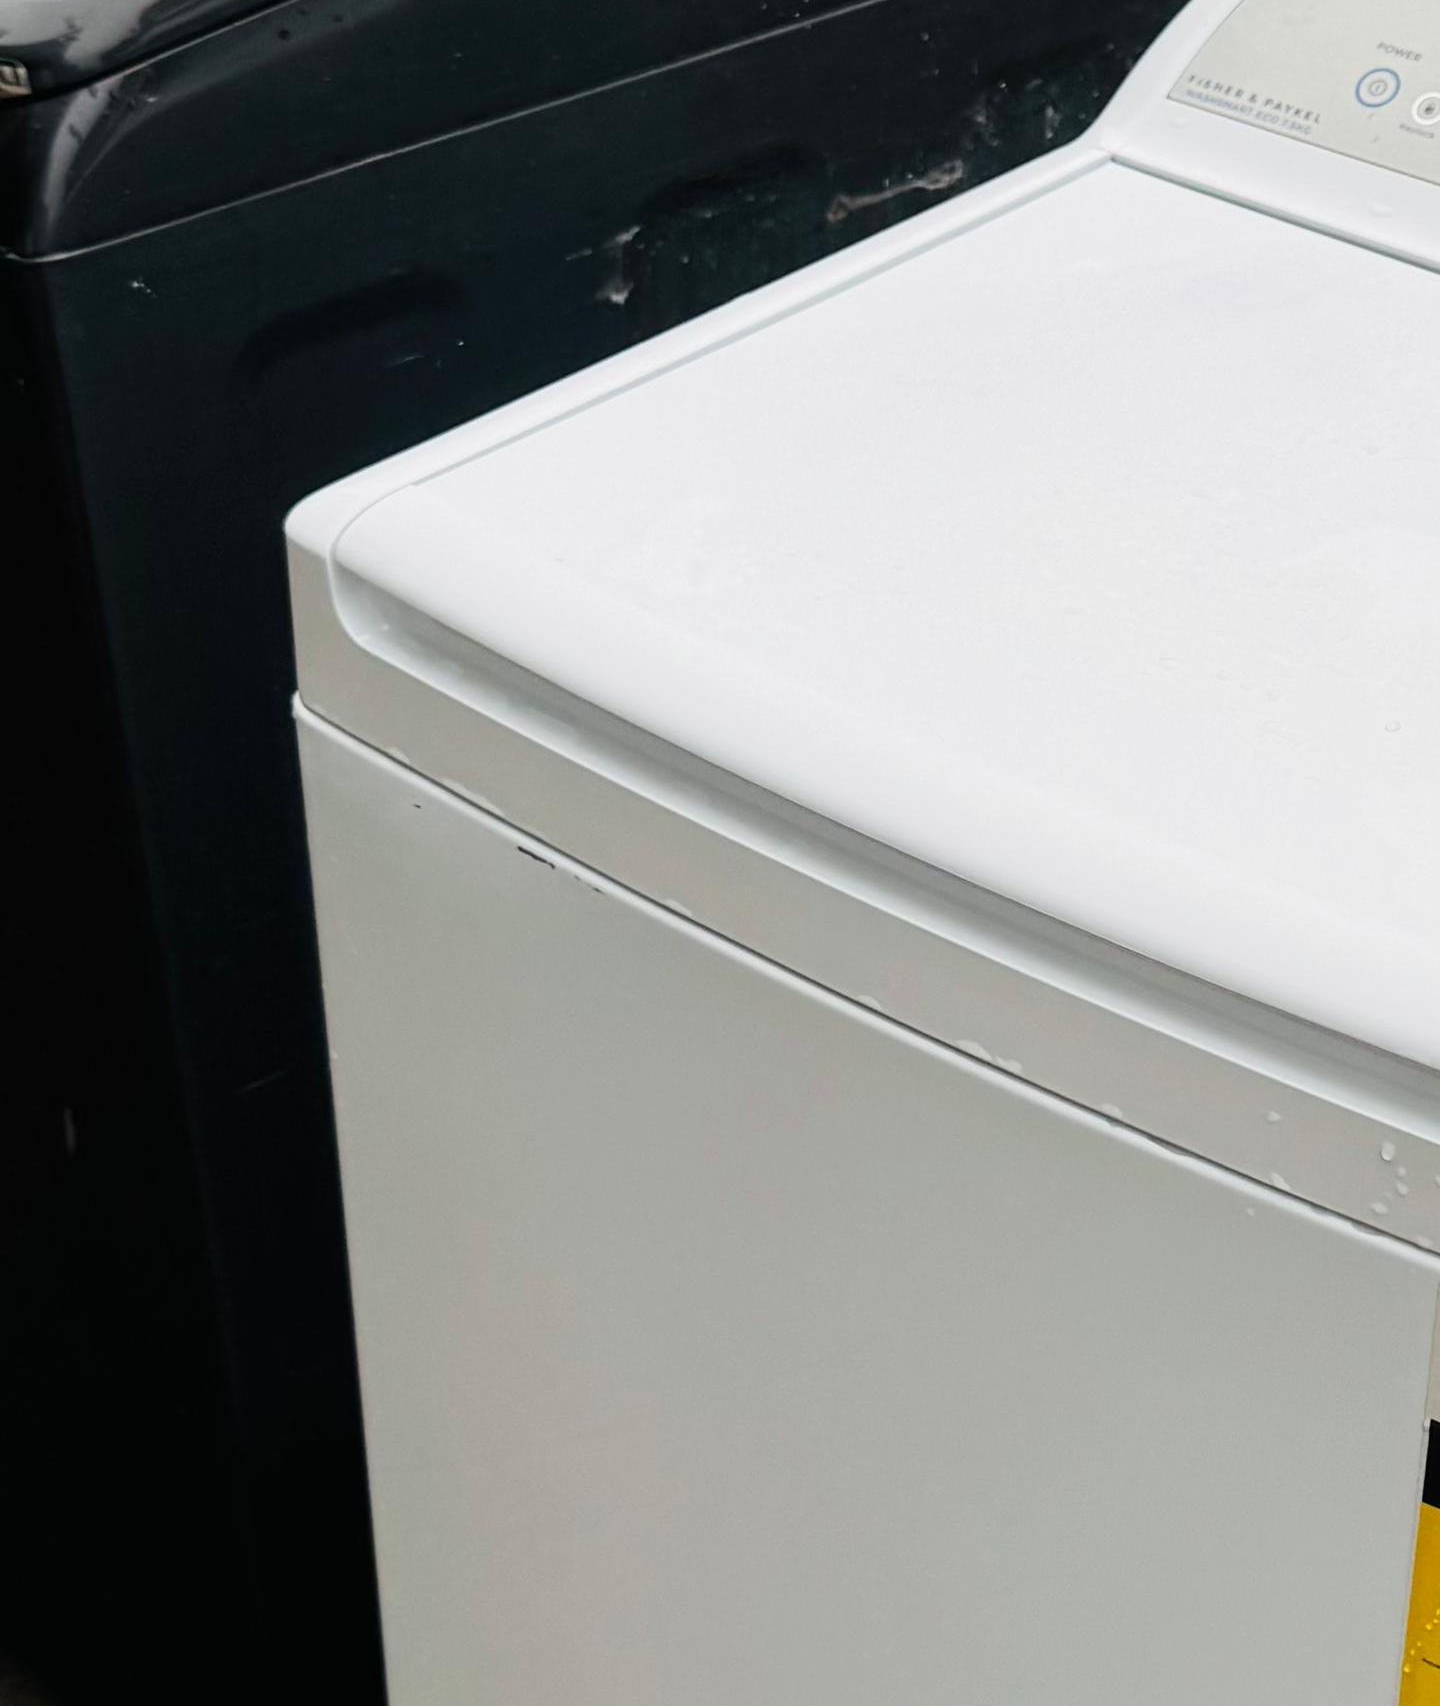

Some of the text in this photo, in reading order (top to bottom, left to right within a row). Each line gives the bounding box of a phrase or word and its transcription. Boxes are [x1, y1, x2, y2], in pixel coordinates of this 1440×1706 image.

[1376, 42, 1423, 62] POWER
[1188, 75, 1321, 124] FISHER & PAYKEL
[1255, 110, 1280, 124] ECO
